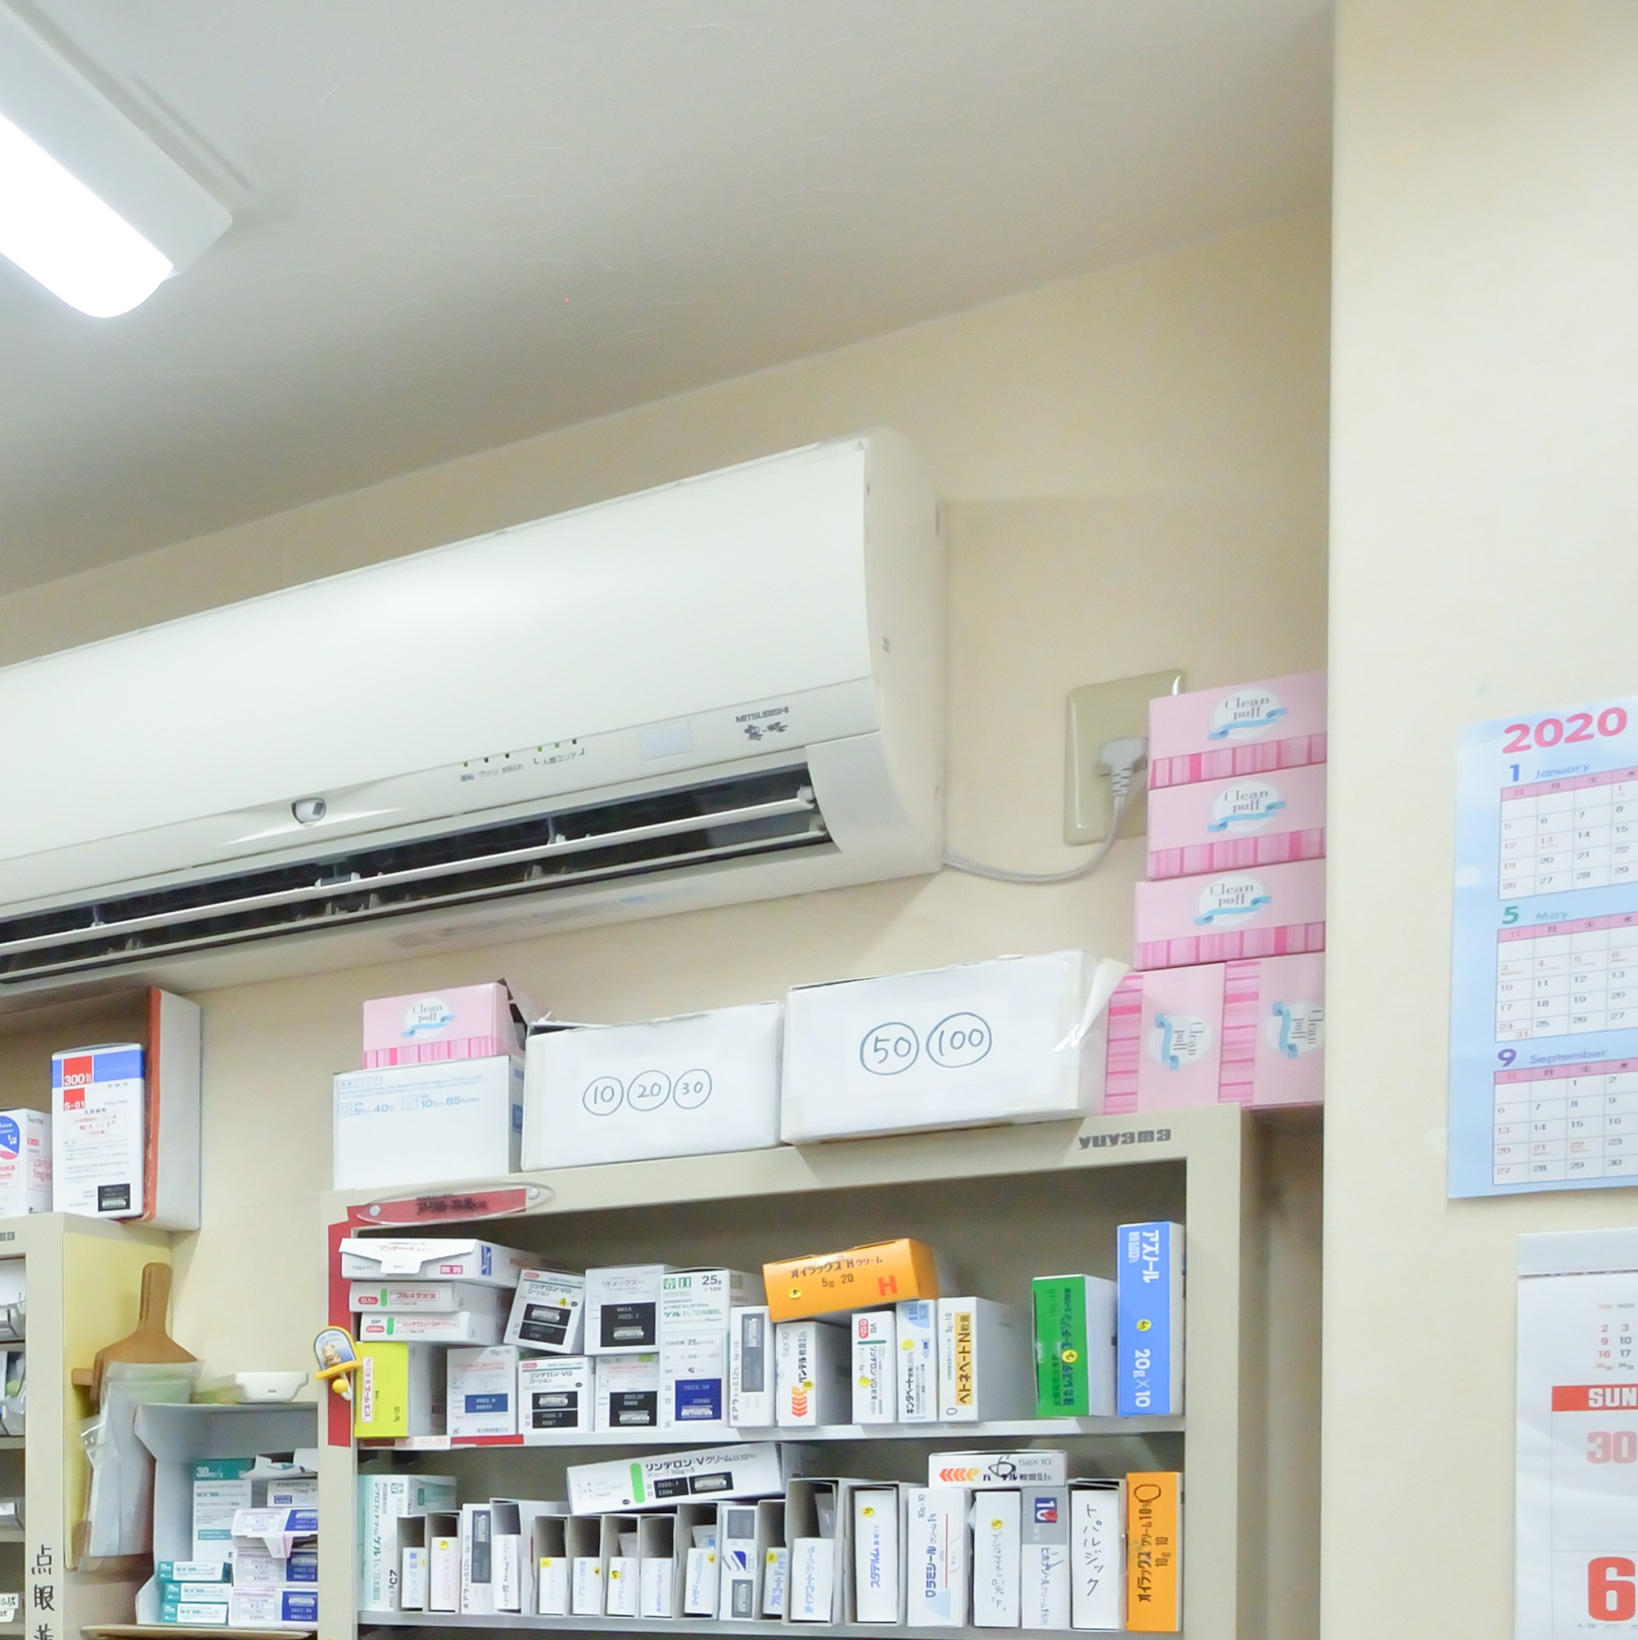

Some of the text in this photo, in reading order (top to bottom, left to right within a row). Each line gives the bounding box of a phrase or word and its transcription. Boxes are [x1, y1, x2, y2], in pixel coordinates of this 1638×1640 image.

[1223, 694, 1270, 710] Clean
[736, 707, 789, 722] MITSUBISHI
[1502, 708, 1627, 754] 2020
[1509, 764, 1590, 782] 1 January
[1223, 788, 1269, 803] Clean
[1232, 798, 1262, 813] puff
[1208, 881, 1254, 896] Clean
[1217, 892, 1247, 908] puff
[1502, 905, 1570, 924] 5 May
[869, 1015, 987, 1070] 50 100
[1174, 1028, 1186, 1057] puff
[1189, 1021, 1198, 1057] Clean
[1498, 1047, 1606, 1066] 9 September
[64, 1073, 85, 1085] 300
[589, 1074, 709, 1110] 10 20 30
[1078, 1128, 1172, 1149] yuyama
[1142, 1230, 1159, 1283] アズノール
[877, 1275, 898, 1296] H
[1134, 1349, 1150, 1408] 20g×10
[1588, 1388, 1638, 1408] SUN
[1587, 1432, 1638, 1464] 30
[1587, 1556, 1635, 1622] 6
